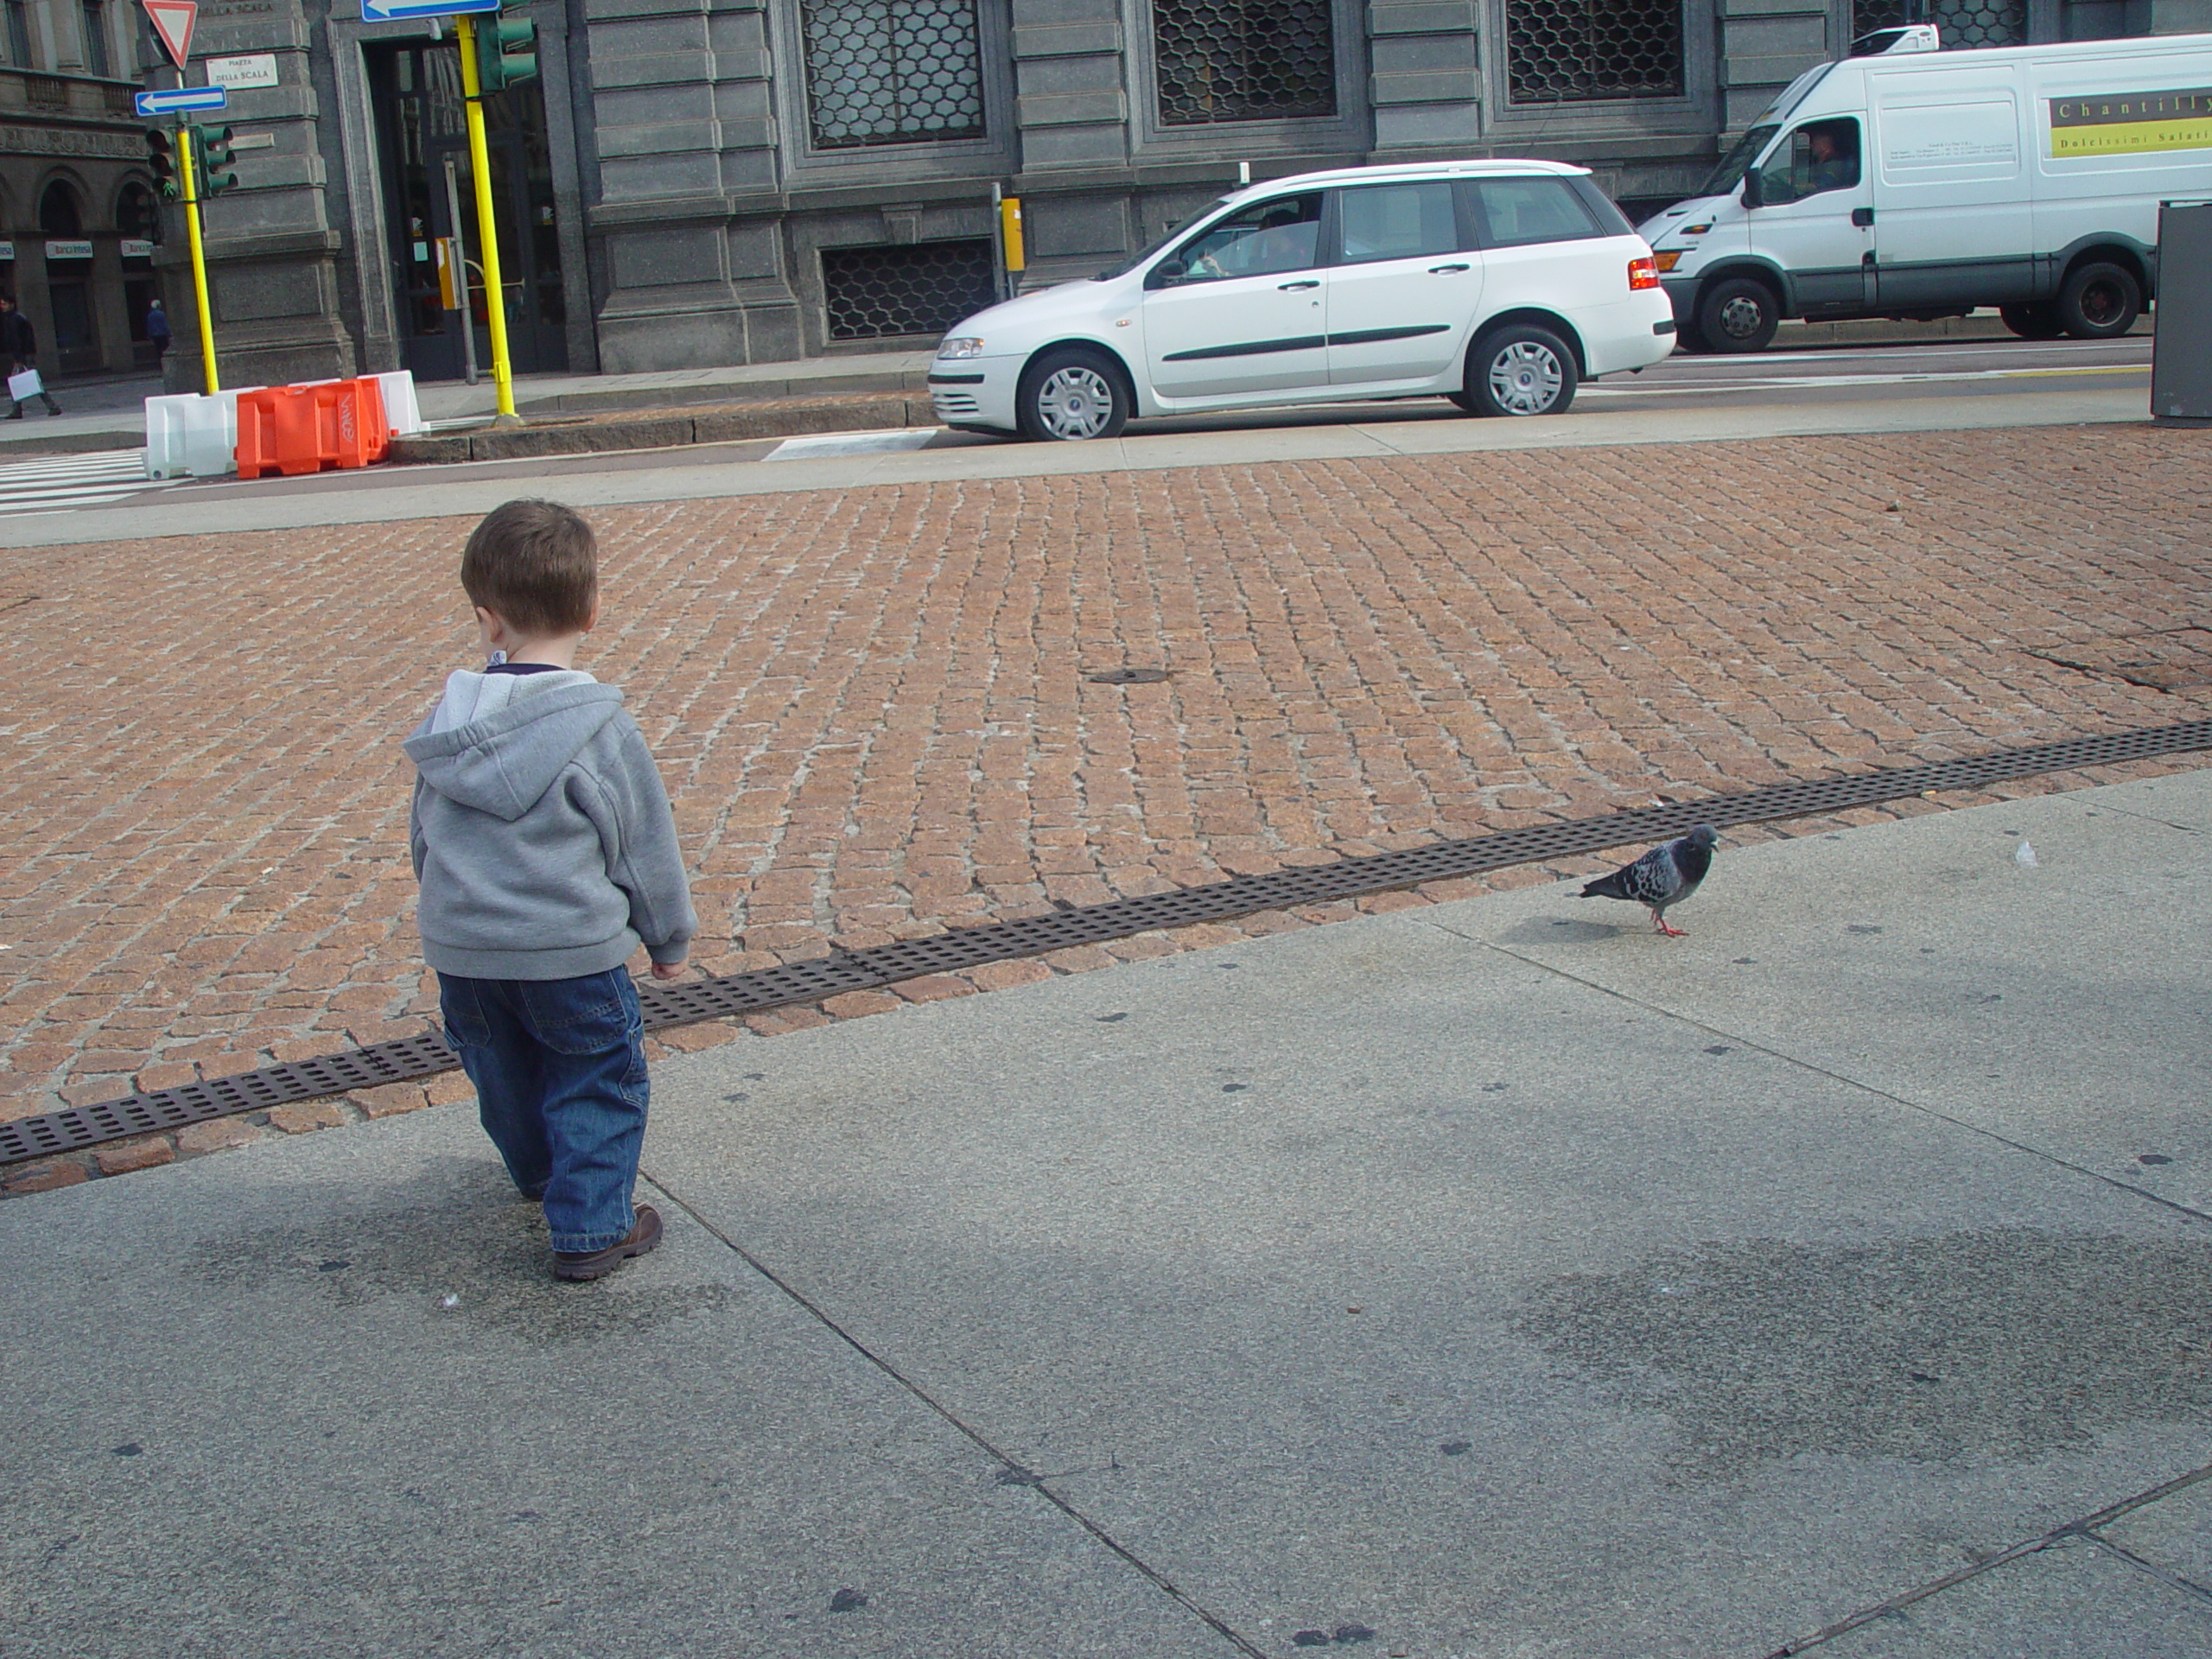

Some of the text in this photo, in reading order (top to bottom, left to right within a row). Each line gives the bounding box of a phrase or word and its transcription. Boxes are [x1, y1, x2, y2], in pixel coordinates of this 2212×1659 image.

[240, 70, 269, 79] SCALA
[2060, 130, 2209, 149] Dolcissimi Salati
